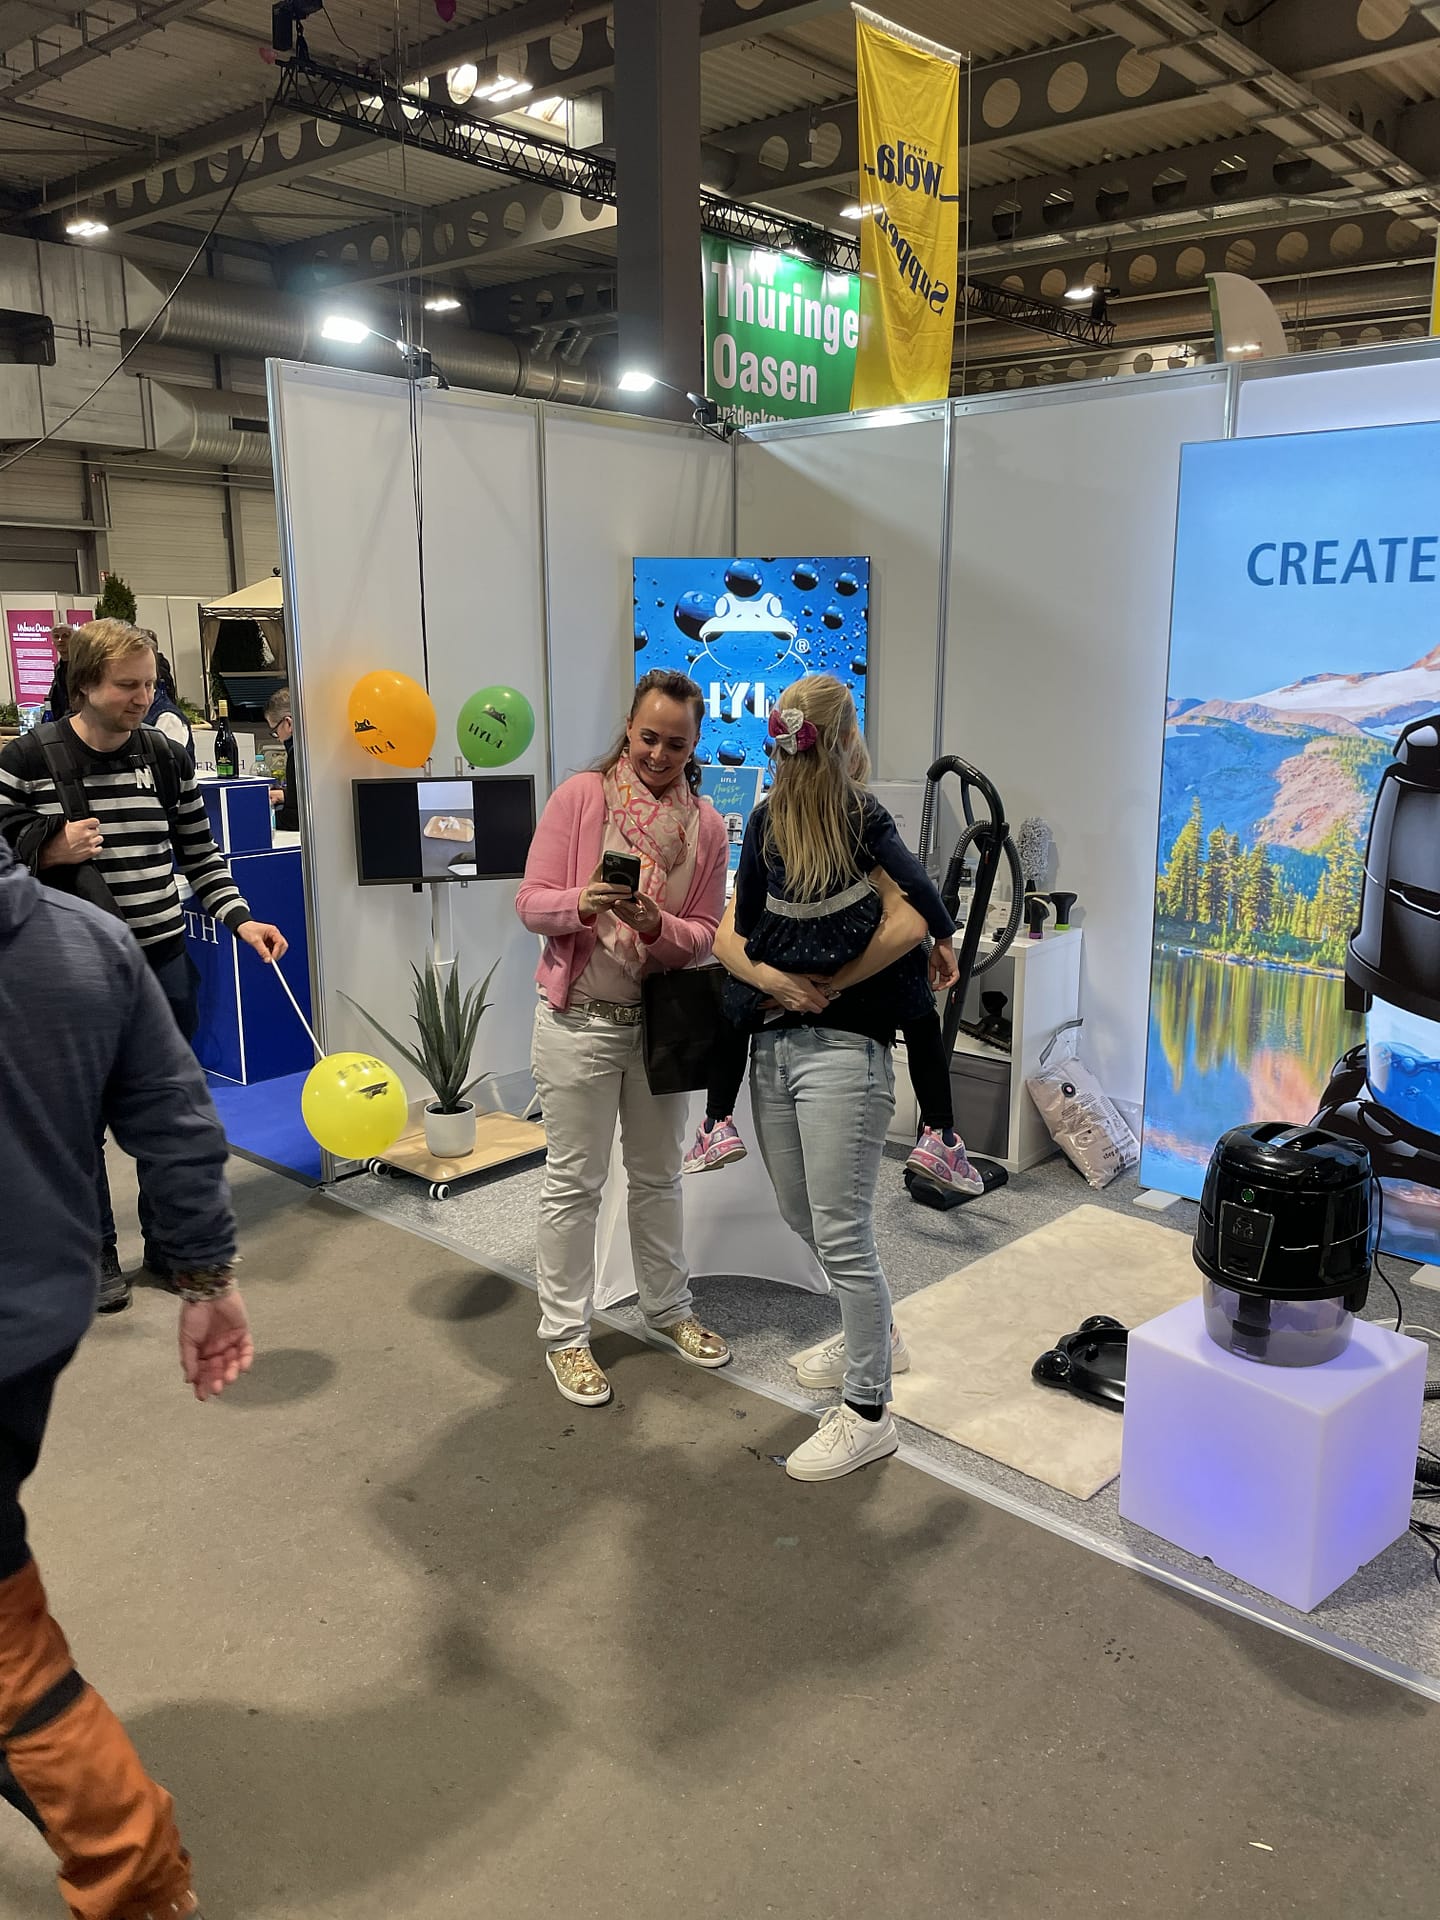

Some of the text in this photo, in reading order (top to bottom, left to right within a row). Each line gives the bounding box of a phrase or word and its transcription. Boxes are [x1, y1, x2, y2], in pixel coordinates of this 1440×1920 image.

[713, 333, 818, 405] Oasen
[1247, 536, 1439, 587] CREATE
[703, 682, 770, 718] HYL
[469, 723, 503, 749] HYLA
